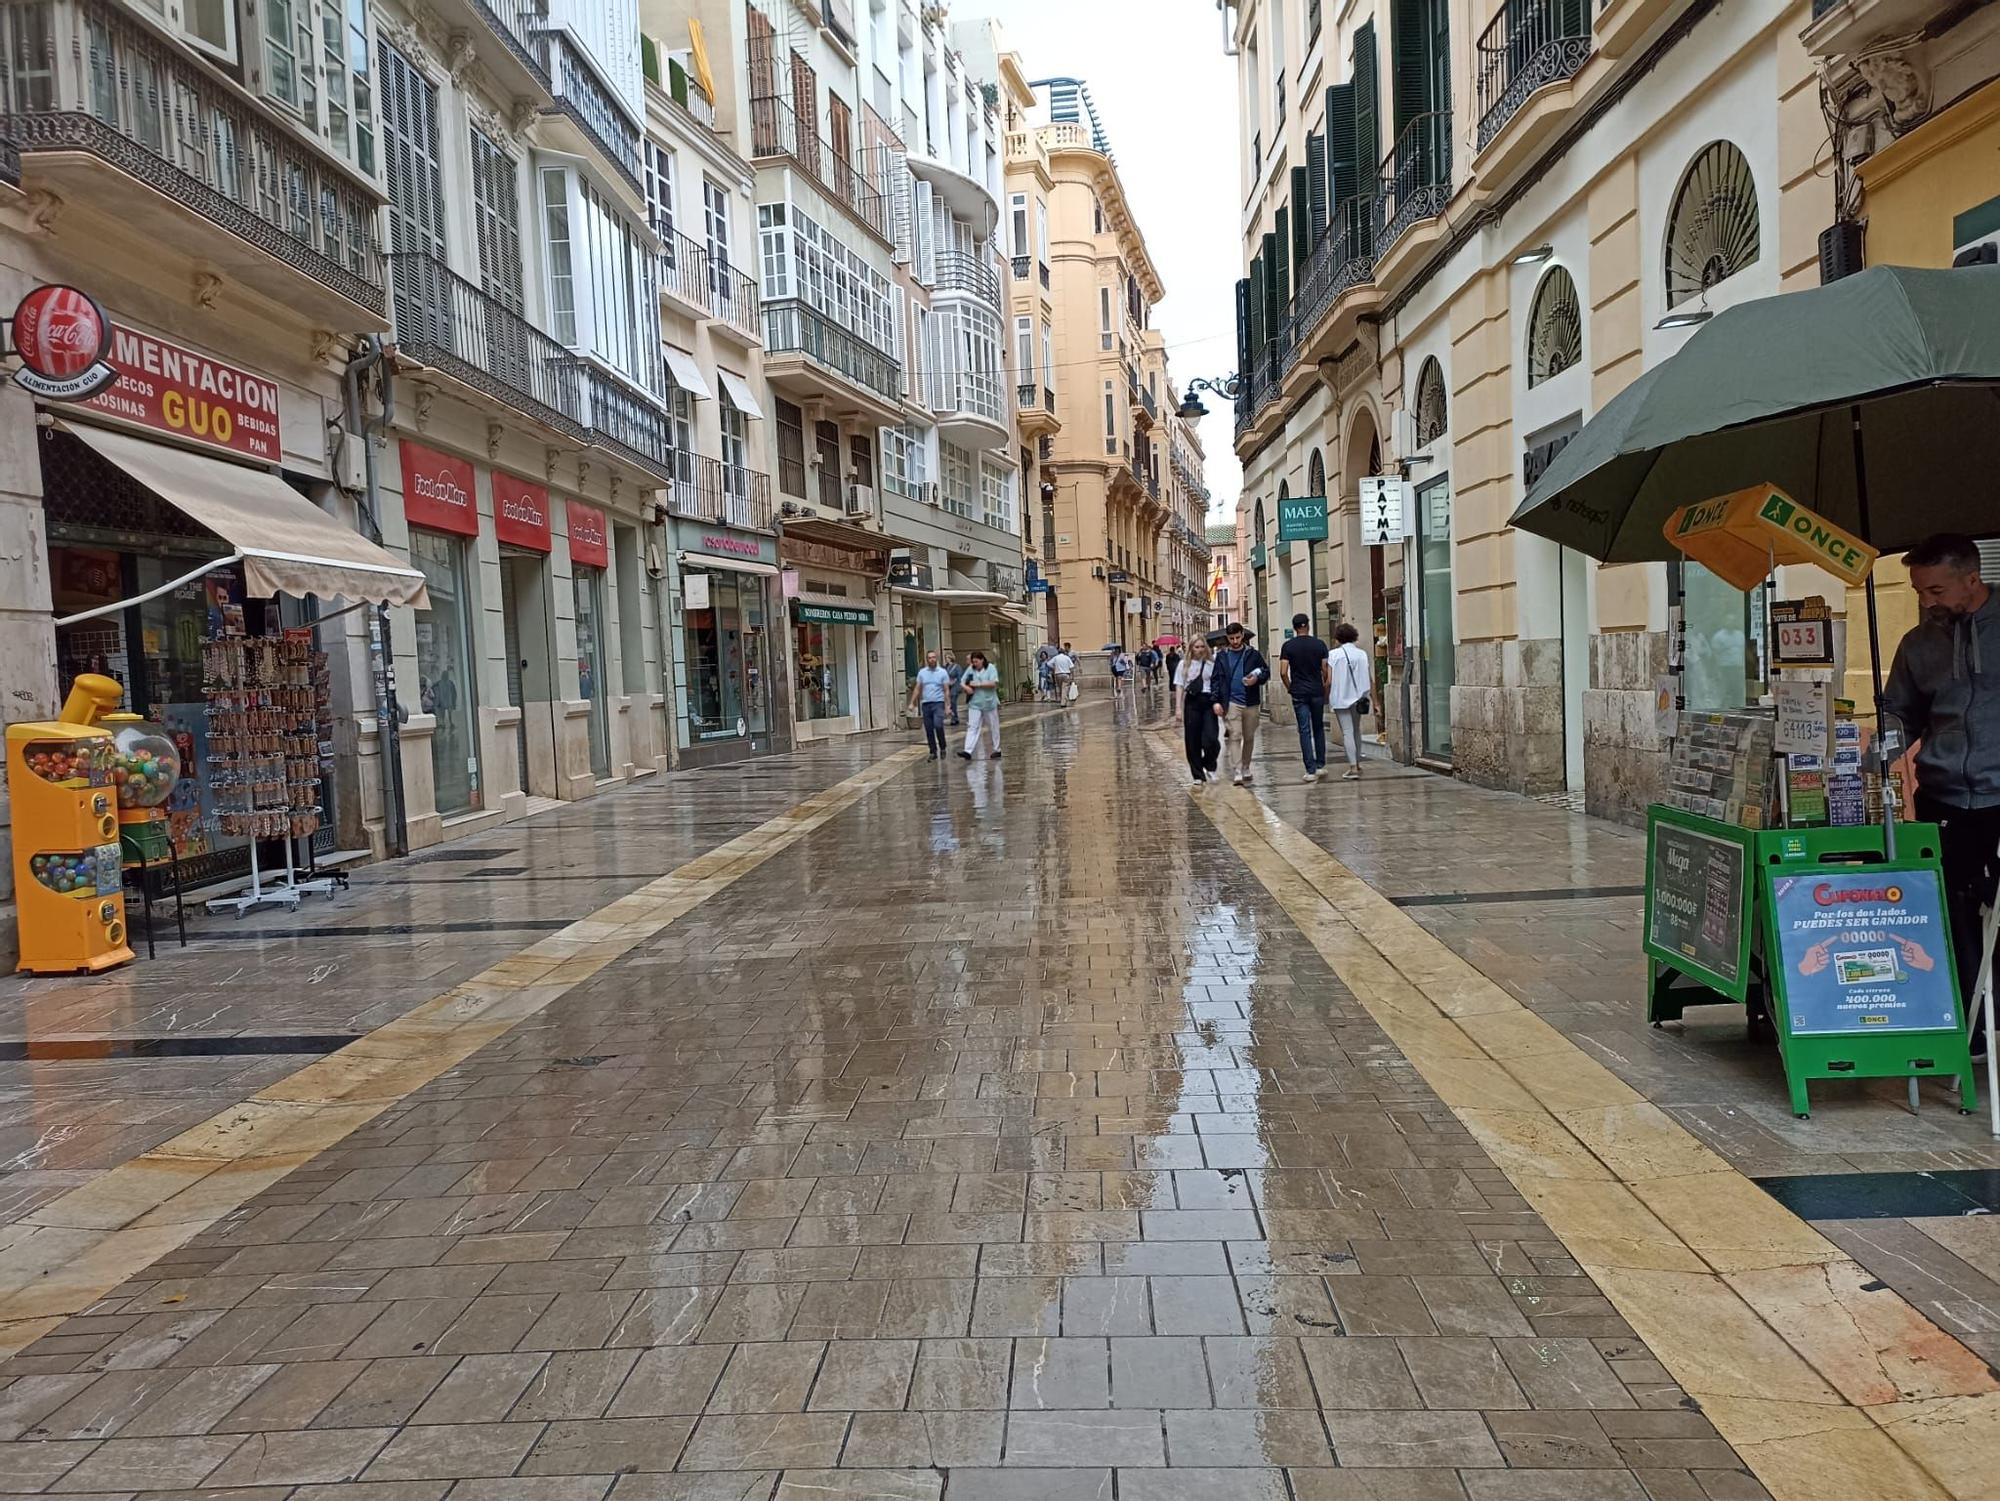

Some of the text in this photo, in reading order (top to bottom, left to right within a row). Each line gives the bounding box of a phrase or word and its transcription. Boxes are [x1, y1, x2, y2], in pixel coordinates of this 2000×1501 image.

[83, 372, 98, 386] GUO
[107, 329, 277, 415] MENTACION
[162, 390, 233, 443] GUO
[237, 413, 276, 436] BEBIDAS
[249, 437, 268, 454] PAN
[415, 473, 435, 498] Foot
[1284, 505, 1323, 520] MAEX
[1377, 479, 1390, 542] PAYMA
[1793, 515, 1861, 569] ONCE
[1780, 627, 1817, 646] 033
[1793, 915, 1929, 929] PUEDES SER GANADOR
[1814, 907, 1907, 919] Por los dos lados
[1840, 930, 1887, 944] 00000
